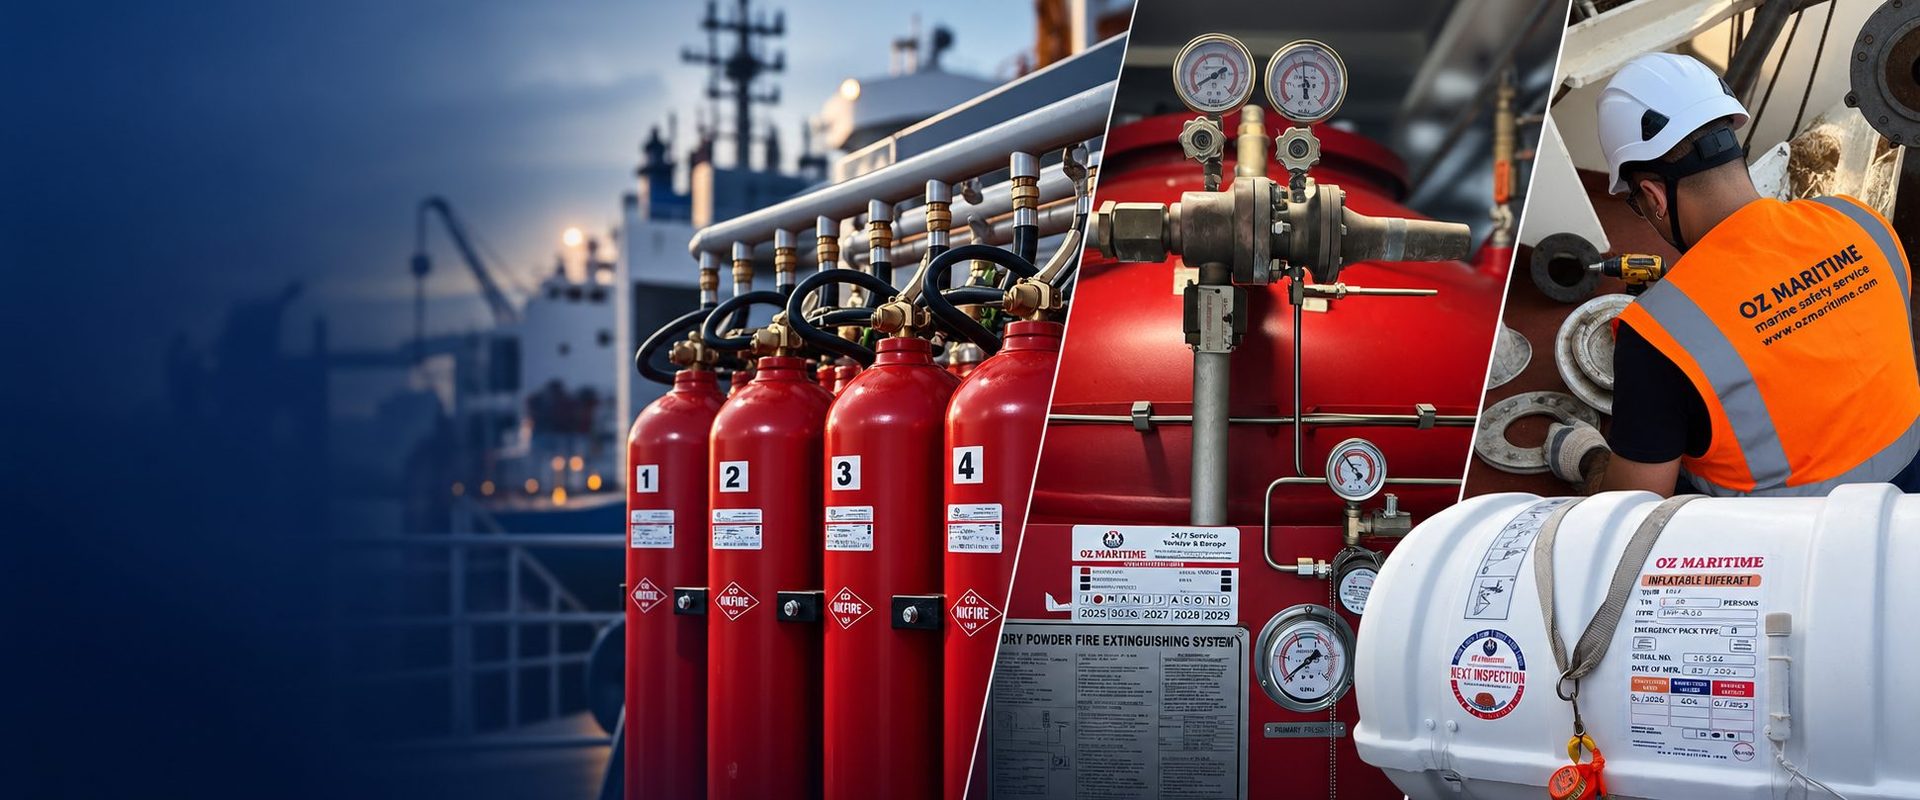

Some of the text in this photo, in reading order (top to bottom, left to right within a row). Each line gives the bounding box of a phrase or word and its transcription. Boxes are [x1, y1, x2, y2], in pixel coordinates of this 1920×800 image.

[1739, 244, 1863, 319] OZ MARITIME
[1754, 264, 1870, 334] marine safety service
[958, 452, 975, 480] 4
[641, 468, 650, 488] 1
[725, 466, 740, 488] 2
[836, 461, 851, 486] 3
[1080, 550, 1094, 559] OZ
[1095, 550, 1147, 559] MARITIME
[1655, 556, 1764, 569] OZ MARITIME
[1648, 575, 1701, 585] INFLATABLE
[1171, 596, 1178, 604] A
[1194, 596, 1202, 604] O
[1208, 596, 1215, 604] N
[1723, 599, 1759, 607] PERSONS
[1144, 609, 1169, 619] 2027
[1174, 610, 1200, 620] 2028
[1204, 610, 1230, 620] 2029
[1678, 627, 1698, 635] PACK
[1001, 633, 1235, 648] DRY POWDER FIRE EXTINGUISHING SYSTEM
[1631, 653, 1657, 661] SERIAL
[1450, 666, 1526, 685] NEXT INSPECTION
[1631, 665, 1649, 673] DATE
[1650, 665, 1660, 673] OF
